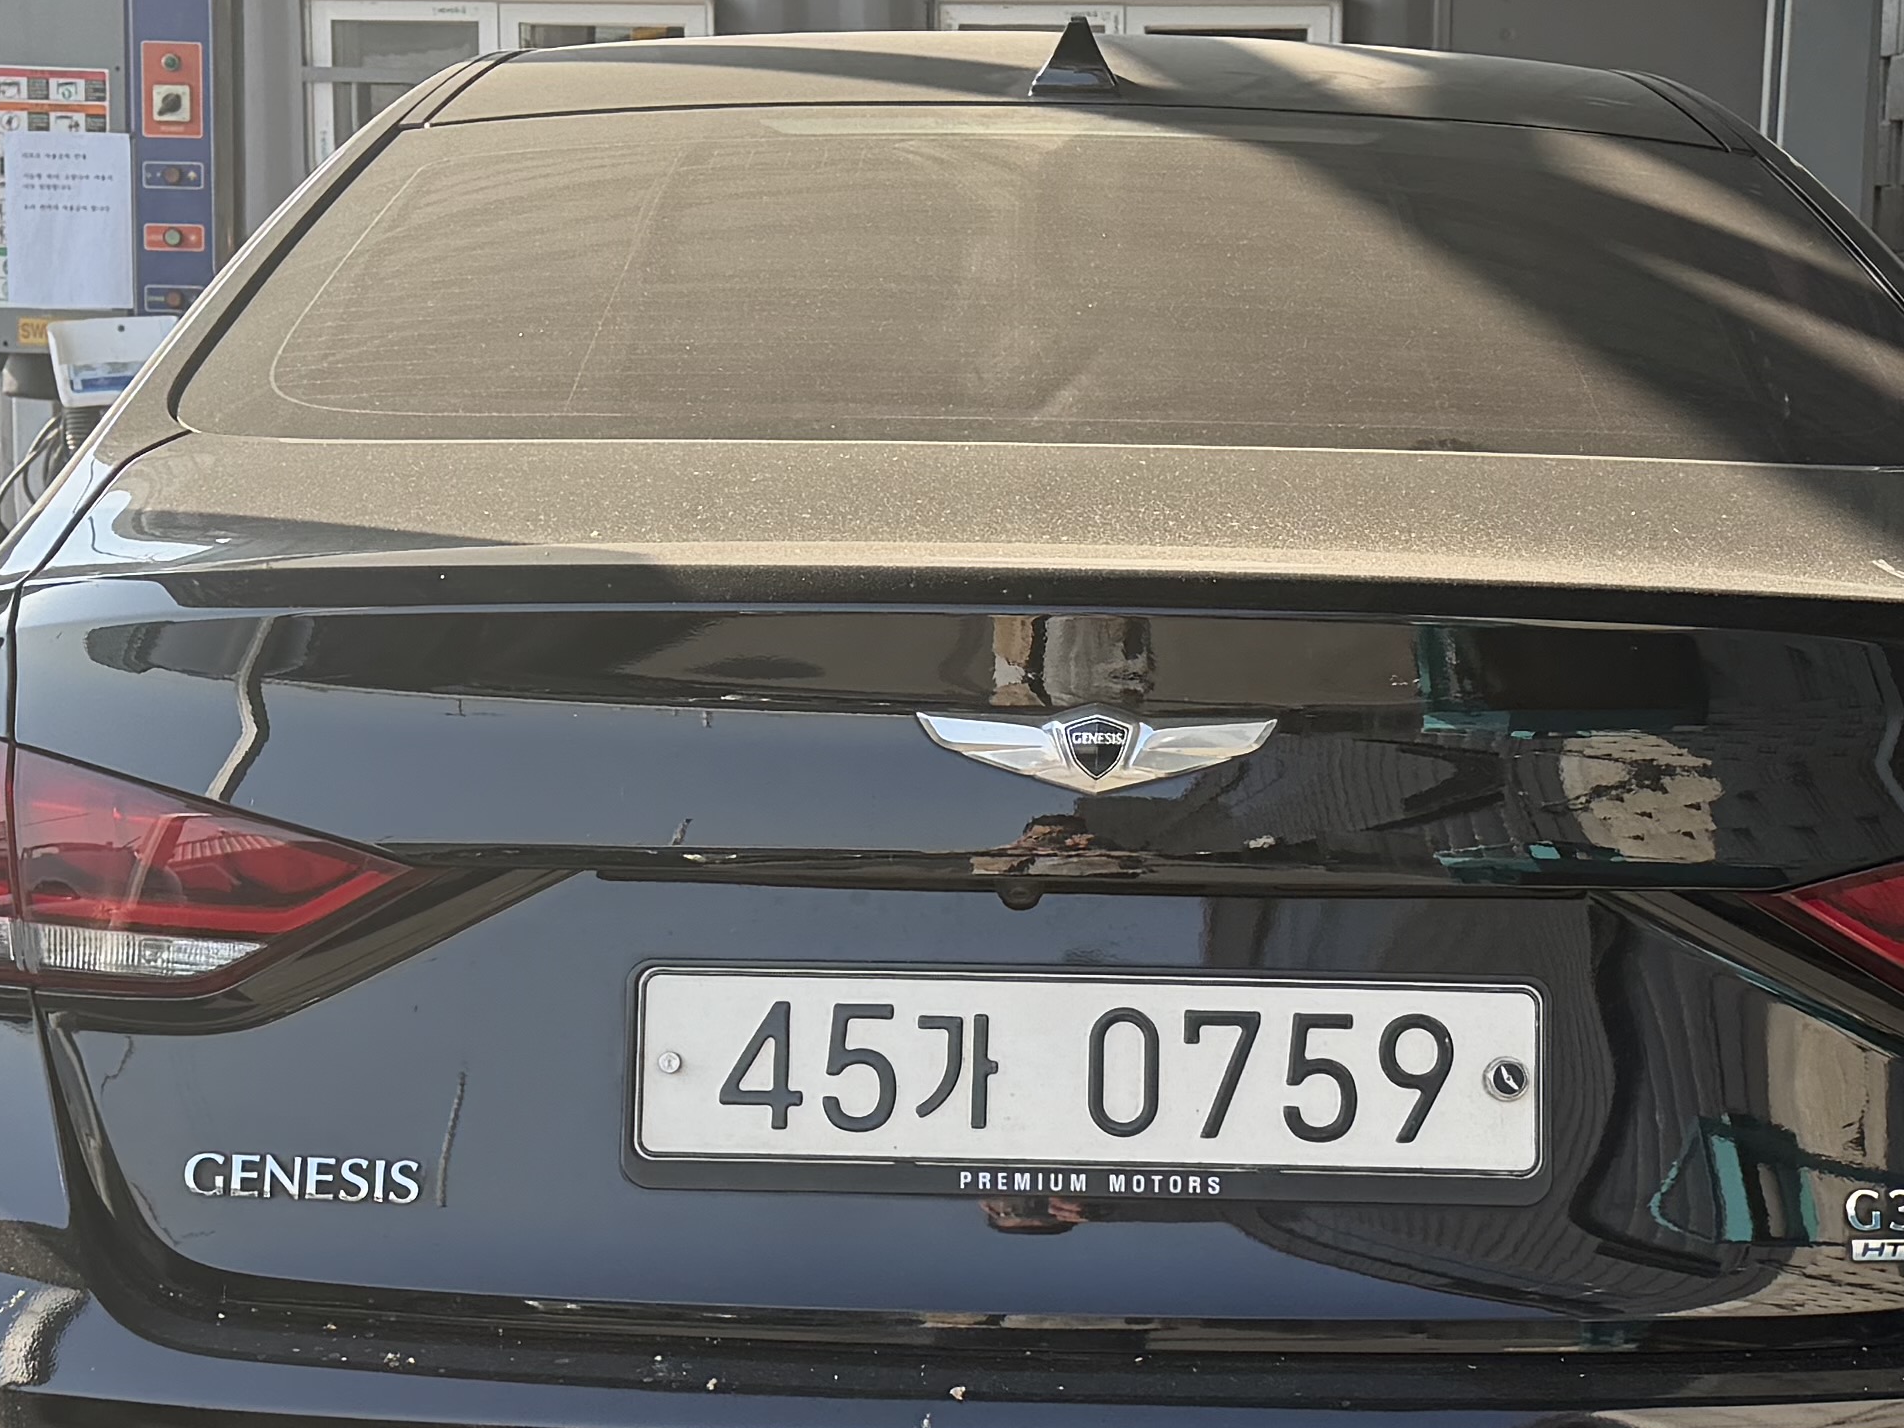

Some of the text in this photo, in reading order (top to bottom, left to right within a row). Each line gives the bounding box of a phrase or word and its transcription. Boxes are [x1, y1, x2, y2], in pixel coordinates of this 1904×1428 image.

[1072, 732, 1124, 745] GENESIS
[718, 1000, 1455, 1144] 45가 0759
[184, 1152, 420, 1204] GENESIS
[959, 1171, 1221, 1195] PREMIUM MOTORS
